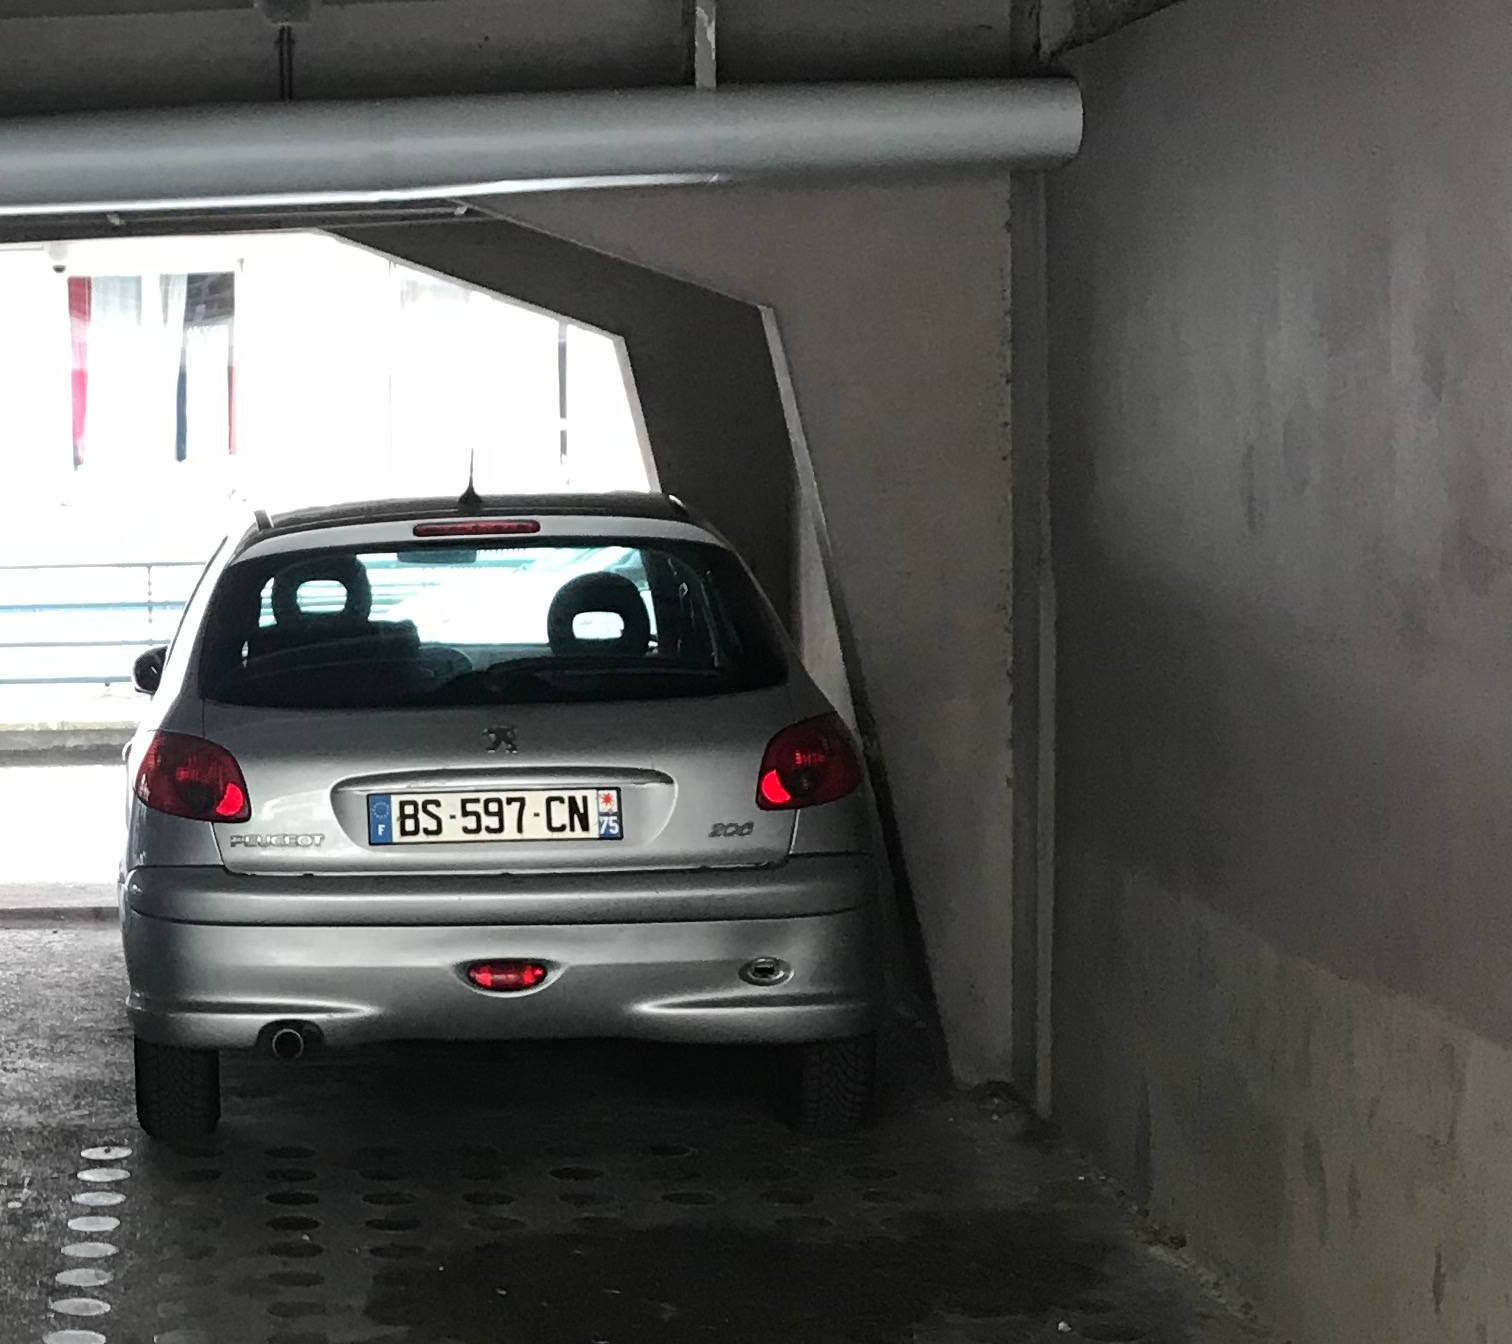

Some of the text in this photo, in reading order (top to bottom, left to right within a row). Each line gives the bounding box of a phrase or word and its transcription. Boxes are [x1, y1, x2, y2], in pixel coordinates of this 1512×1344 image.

[398, 795, 590, 837] BS-597-CN
[377, 824, 386, 836] F
[599, 815, 620, 835] 75
[230, 833, 326, 848] PEUGEOT
